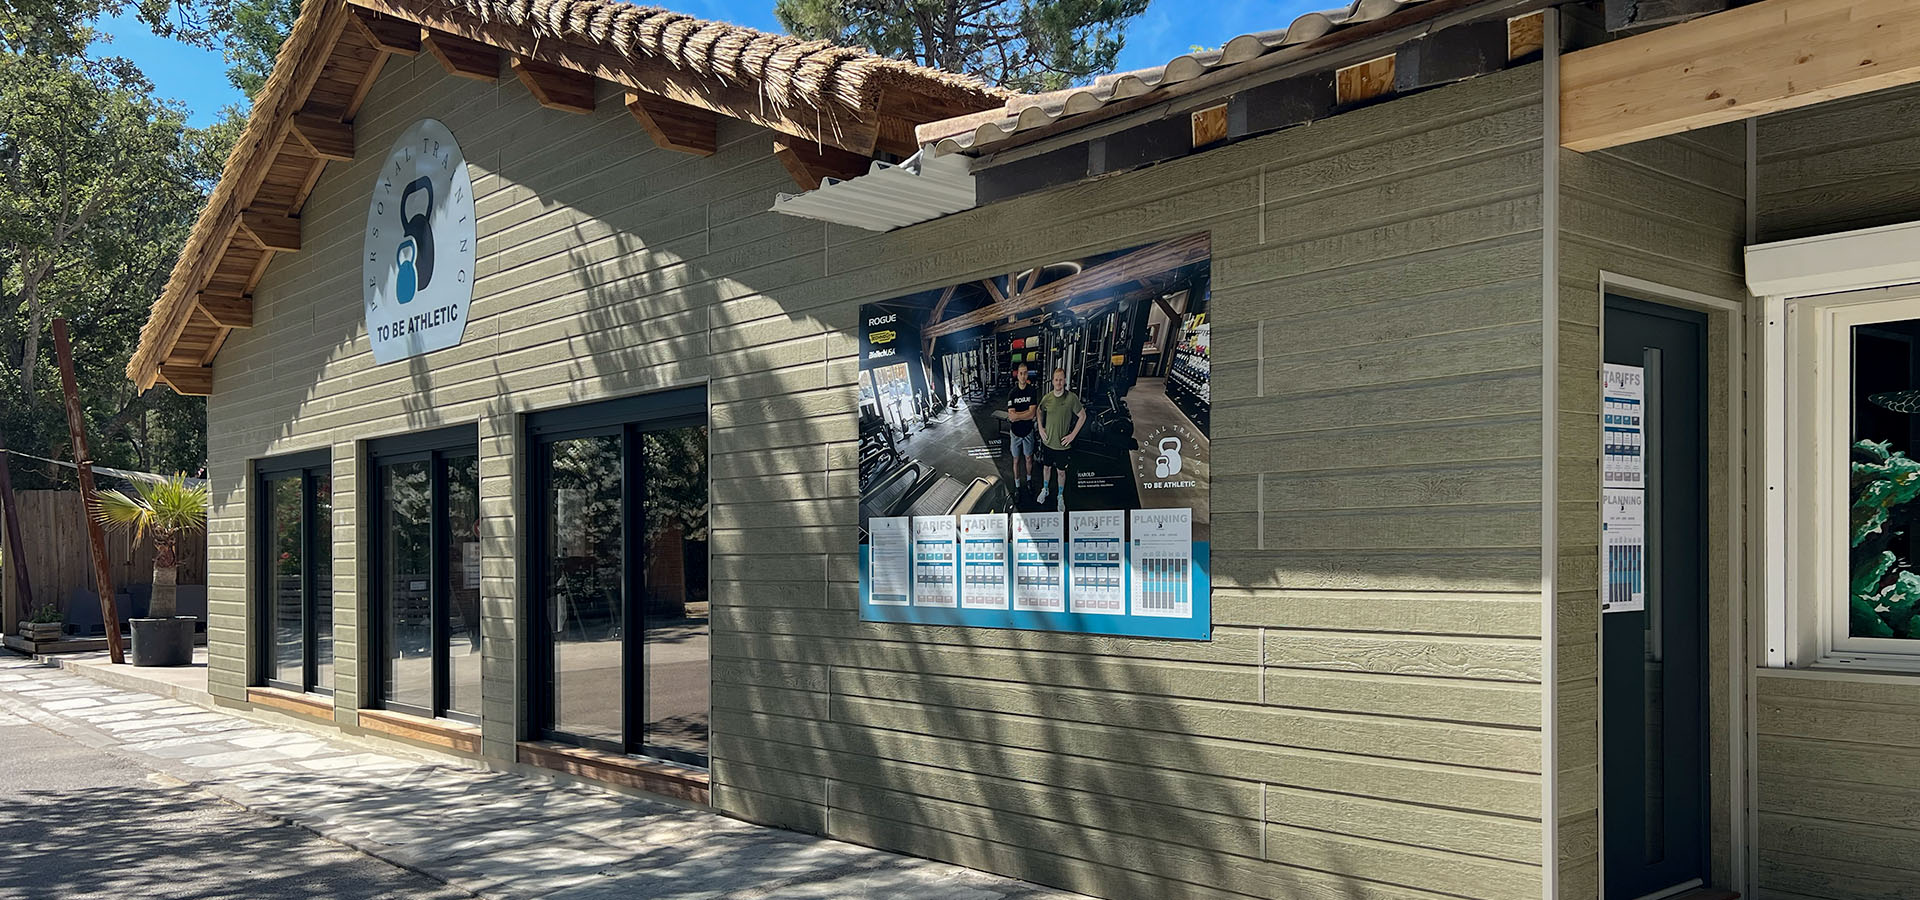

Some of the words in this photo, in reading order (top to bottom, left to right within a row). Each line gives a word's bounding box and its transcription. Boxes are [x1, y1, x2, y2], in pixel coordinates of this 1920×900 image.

[370, 147, 412, 312] PERSONAL
[423, 138, 468, 283] TRAINING
[377, 324, 389, 342] TO
[392, 319, 405, 339] BE
[407, 303, 459, 335] ATHLETIC
[868, 313, 897, 327] ROGUE
[1603, 371, 1641, 386] TARIFFS
[1138, 426, 1167, 478] PERSONAL
[1173, 424, 1201, 475] TRAINING
[1163, 480, 1196, 489] ATHLETIC
[1603, 495, 1642, 506] PLANNING
[965, 518, 1004, 530] TARIFE
[1016, 516, 1060, 529] TARIFFS
[1073, 515, 1120, 527] TARIFFE
[1133, 514, 1188, 524] PLANNING
[917, 520, 953, 531] TARIFS
